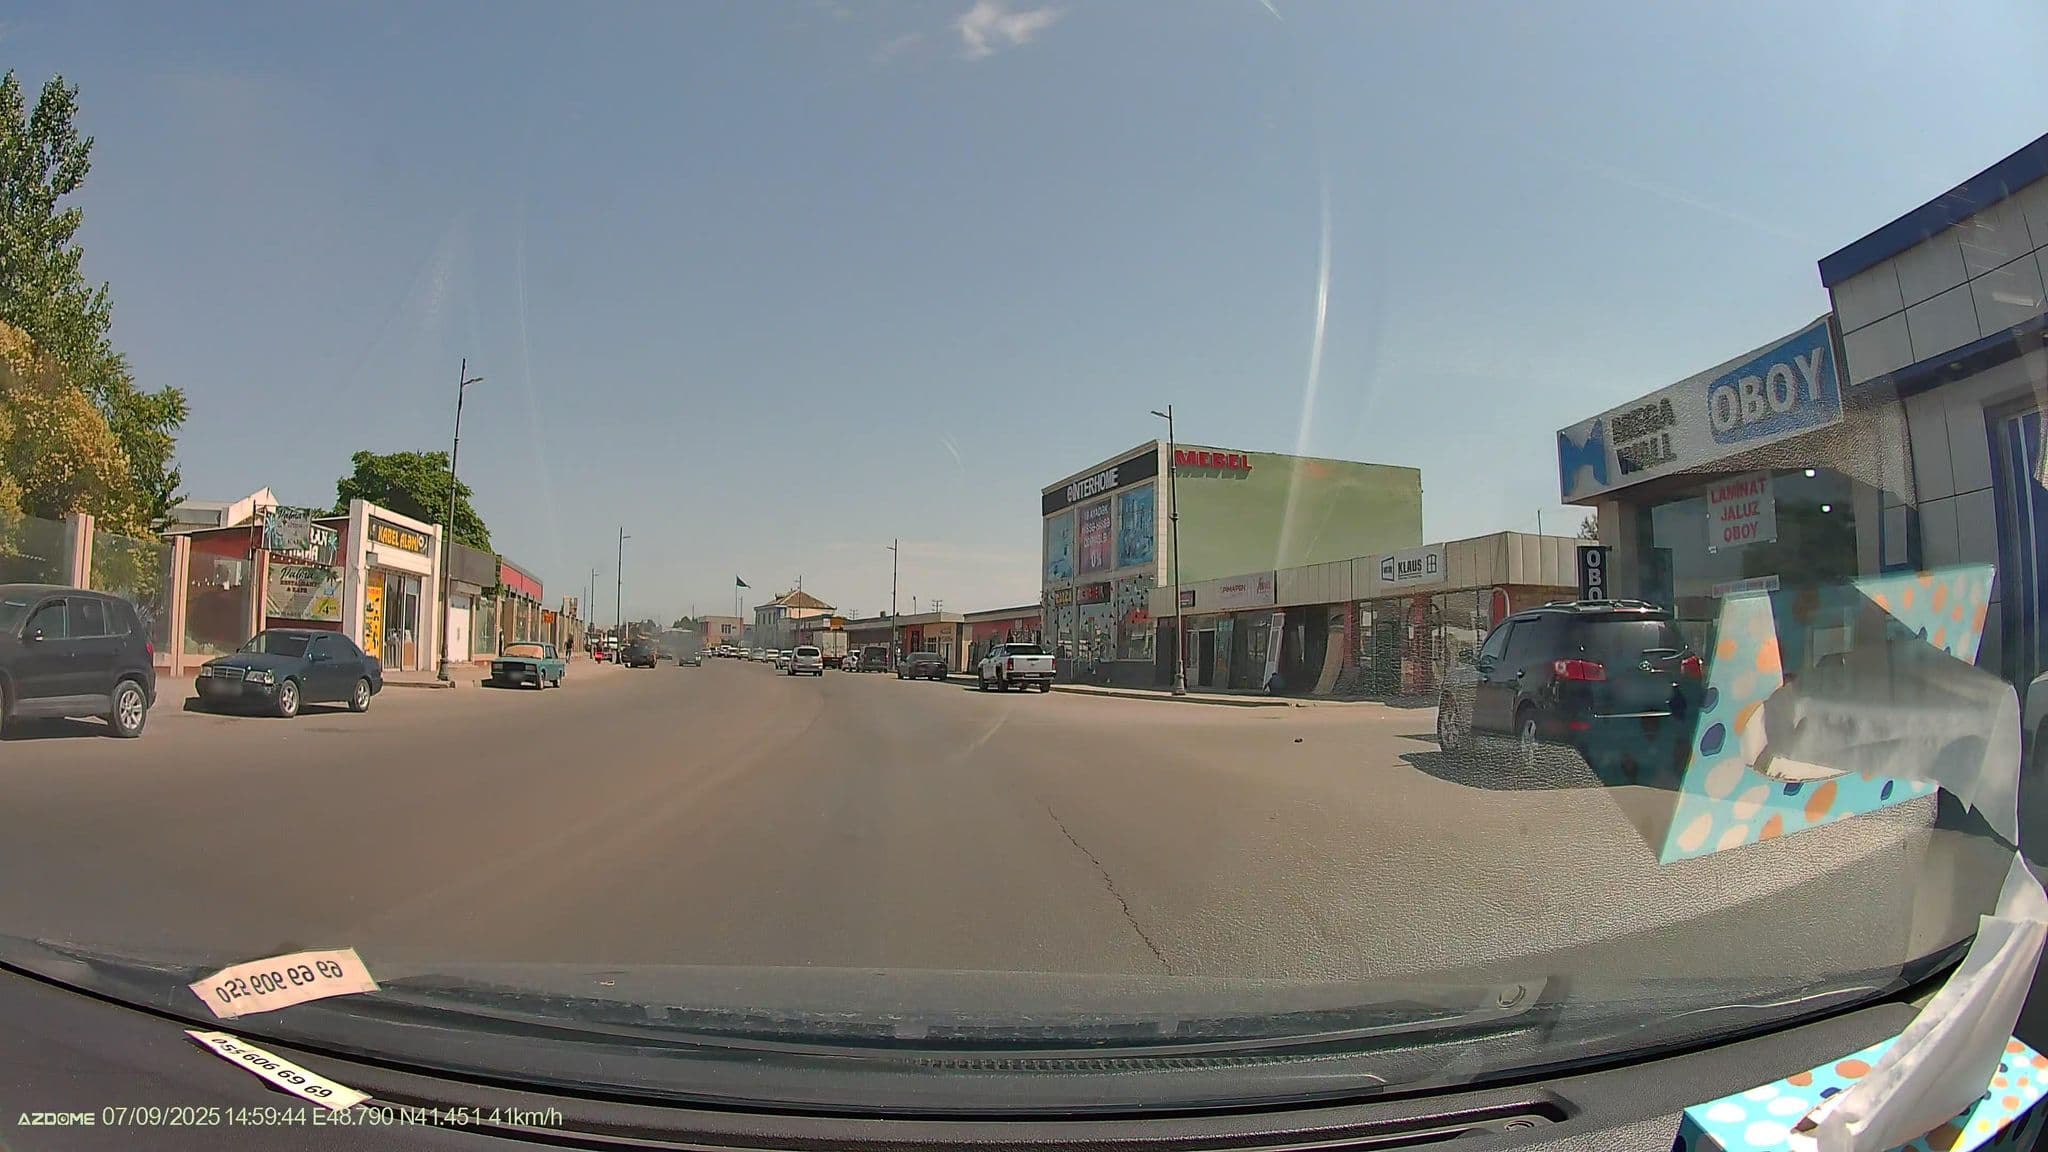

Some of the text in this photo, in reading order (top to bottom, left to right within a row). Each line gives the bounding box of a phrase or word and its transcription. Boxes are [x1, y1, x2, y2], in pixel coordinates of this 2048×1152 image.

[1712, 347, 1824, 431] OBOY
[1175, 450, 1253, 470] MEBEL
[378, 525, 399, 546] KABEL
[1723, 521, 1758, 543] OBOY
[1398, 559, 1422, 573] KLAUS
[1587, 550, 1602, 600] OBO
[211, 1038, 333, 1098] 055 606 69 69
